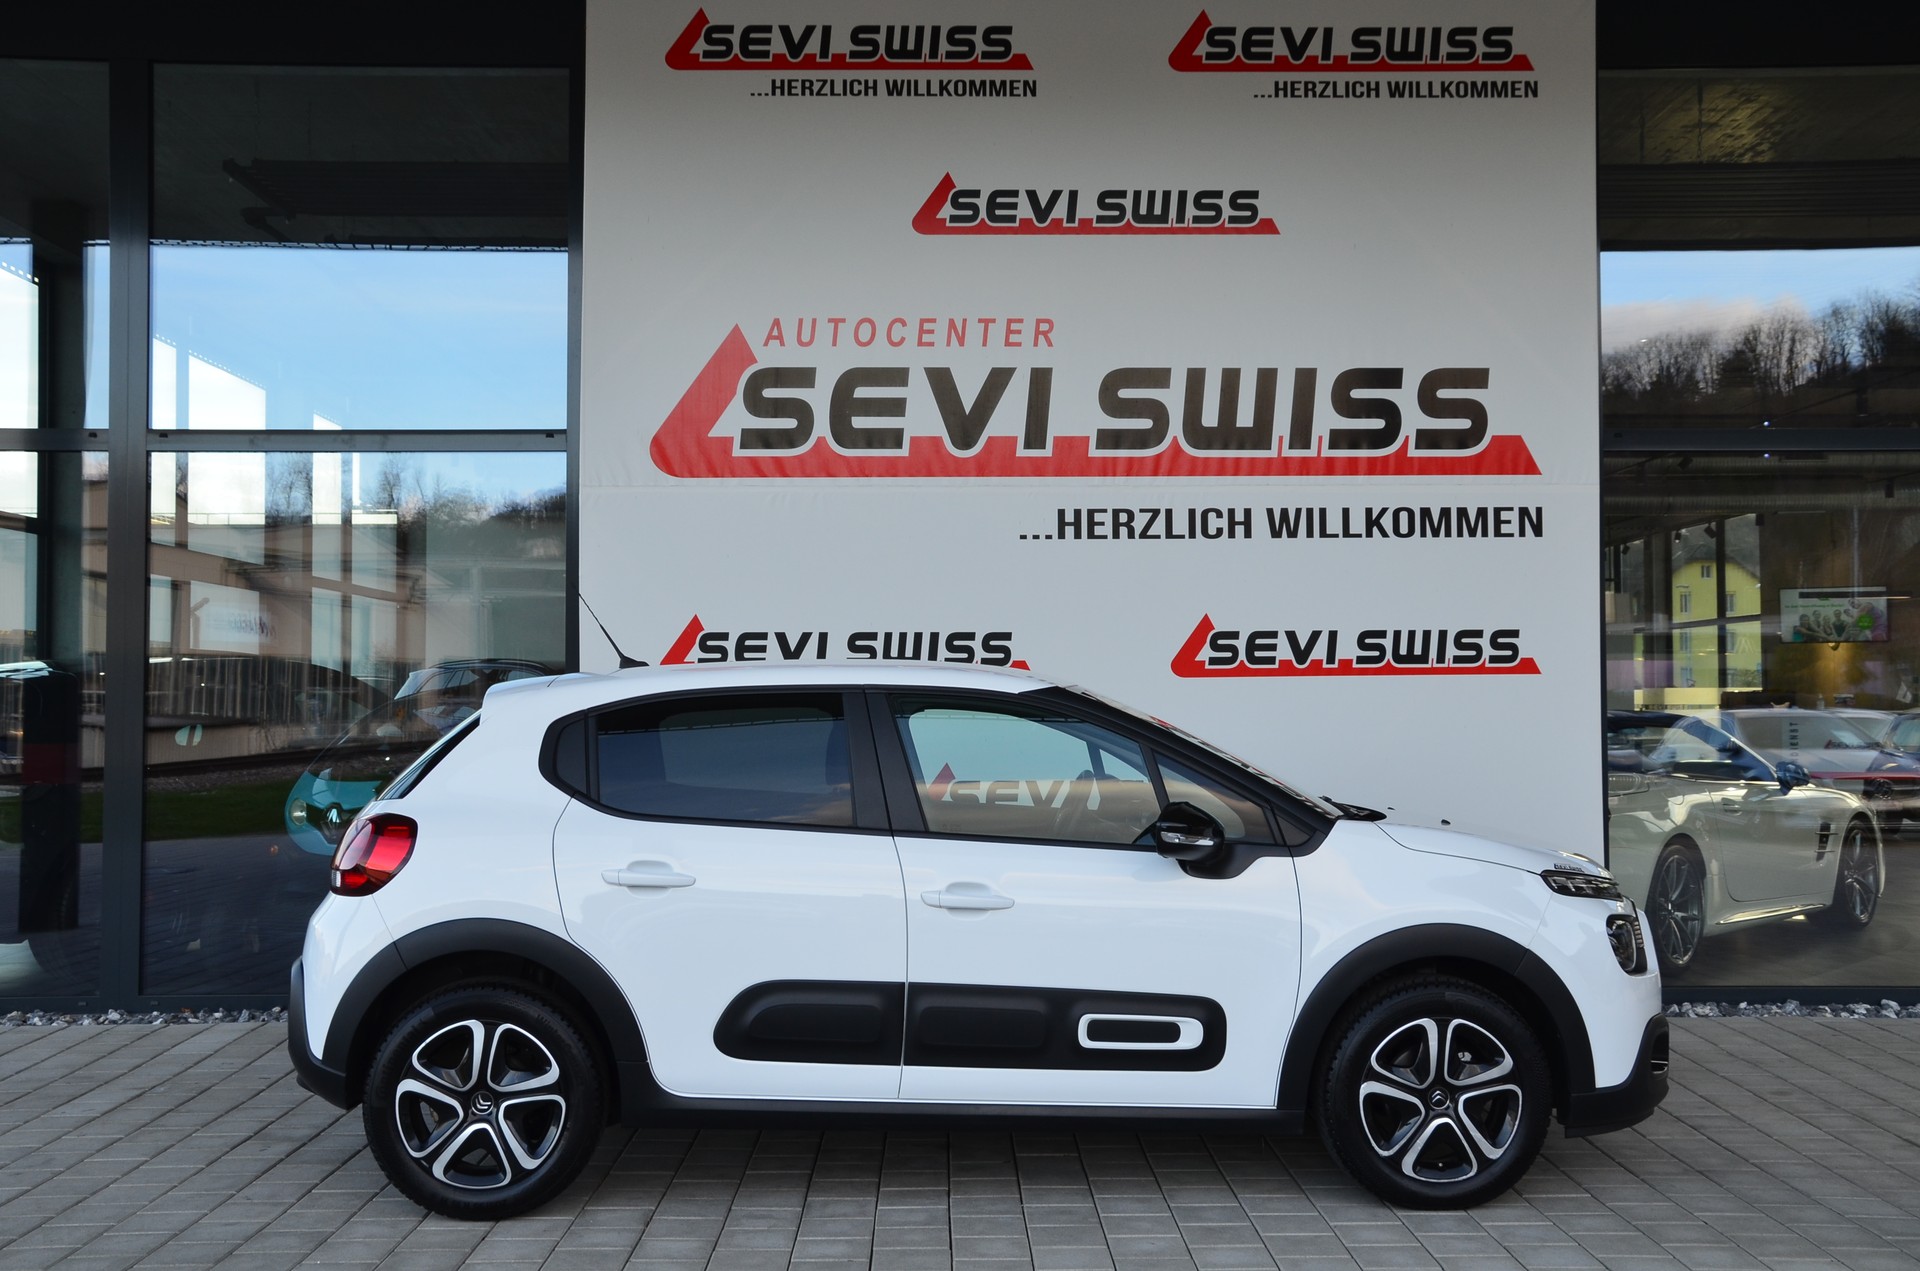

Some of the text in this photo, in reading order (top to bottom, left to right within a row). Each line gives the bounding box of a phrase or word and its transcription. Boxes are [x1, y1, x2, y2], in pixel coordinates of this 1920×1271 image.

[702, 25, 1013, 60] SEVI SWISS
[1204, 27, 1514, 62] SEVI SWISS
[750, 79, 1037, 97] ...HERZLICH WILLKOMMEN
[1253, 81, 1538, 98] ...HERZLICH WILLKOMMEN
[948, 189, 1260, 225] SEVI SWISS
[763, 317, 1055, 347] AUTOCENTER
[739, 367, 1490, 451] SEVI SWISS
[1020, 507, 1543, 539] ...HERZLICH WILLKOMMEN
[697, 631, 1013, 666] SEVI SWISS
[1208, 629, 1520, 666] SEVI SWISS
